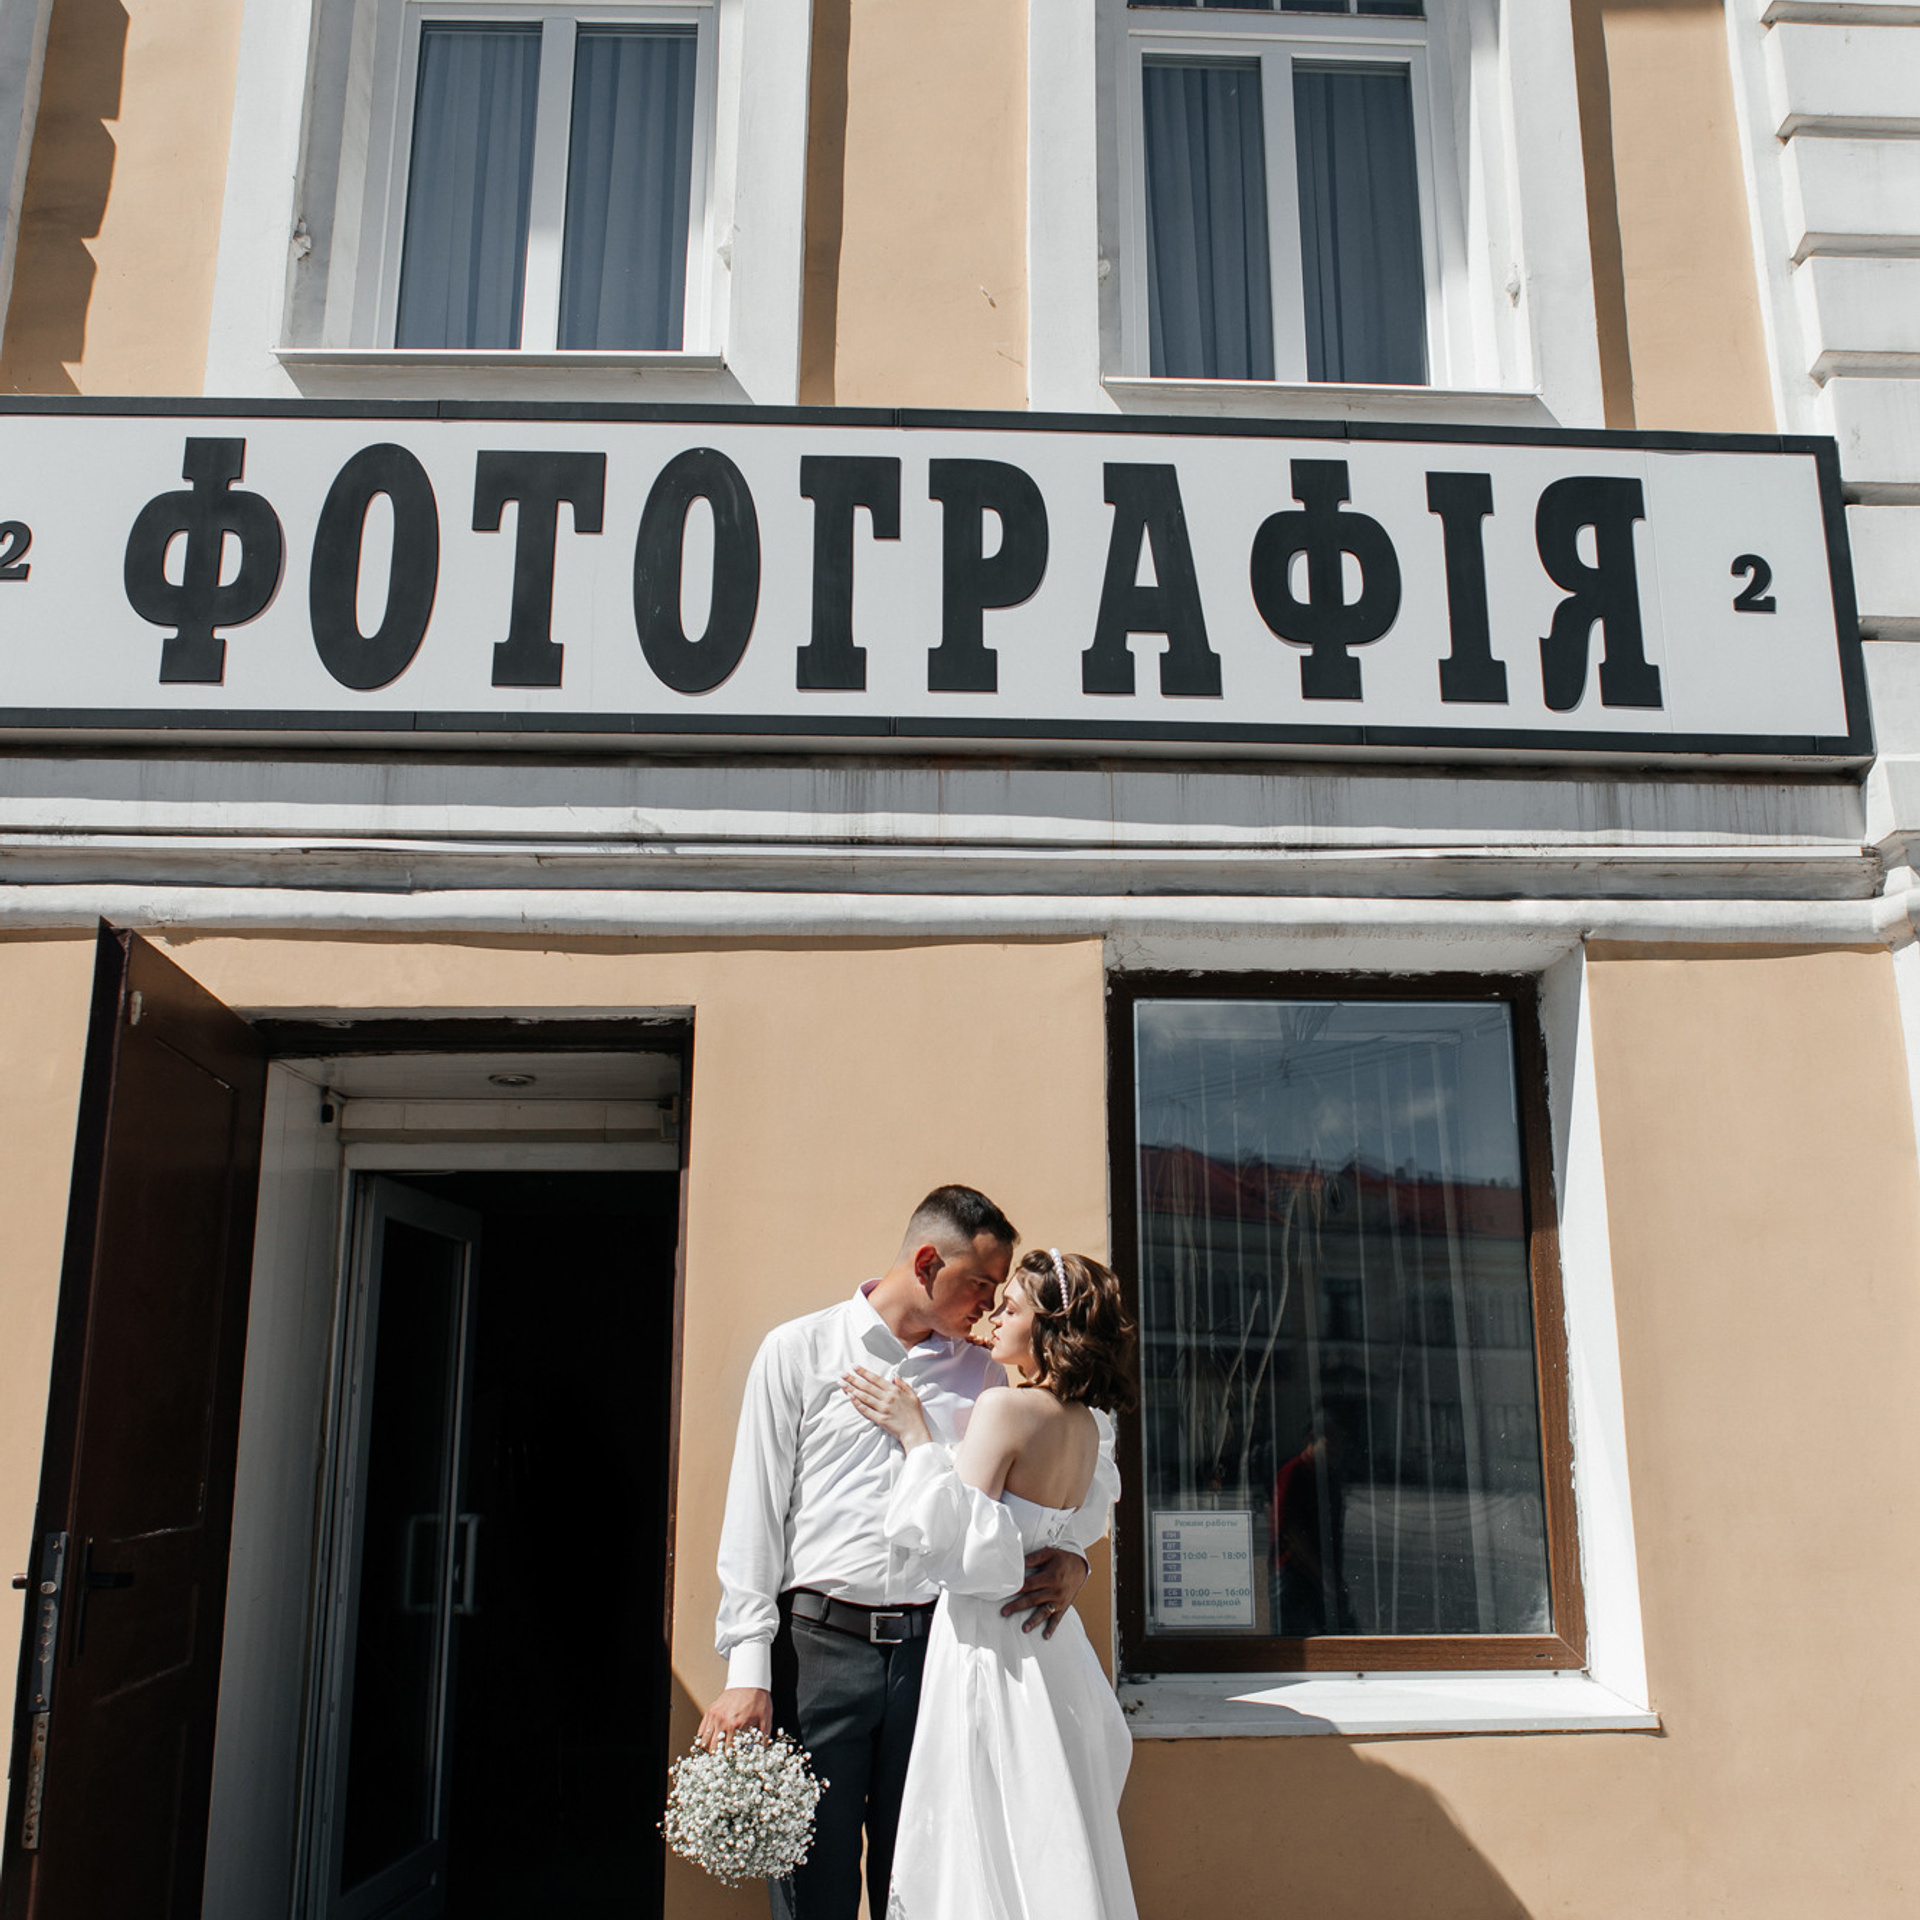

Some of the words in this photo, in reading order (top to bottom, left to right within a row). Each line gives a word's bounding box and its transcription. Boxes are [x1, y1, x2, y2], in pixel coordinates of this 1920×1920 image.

[0, 520, 32, 581] 2
[124, 437, 1664, 712] ФОТОГРАФІЯ
[1731, 554, 1777, 614] 2
[1174, 1519, 1204, 1527] Режим
[1205, 1518, 1238, 1528] работы
[1183, 1552, 1208, 1560] 10:00
[1222, 1551, 1247, 1560] 18:00
[1185, 1588, 1210, 1597] 10:00
[1225, 1588, 1251, 1596] 16:00
[1191, 1598, 1242, 1607] выходной
